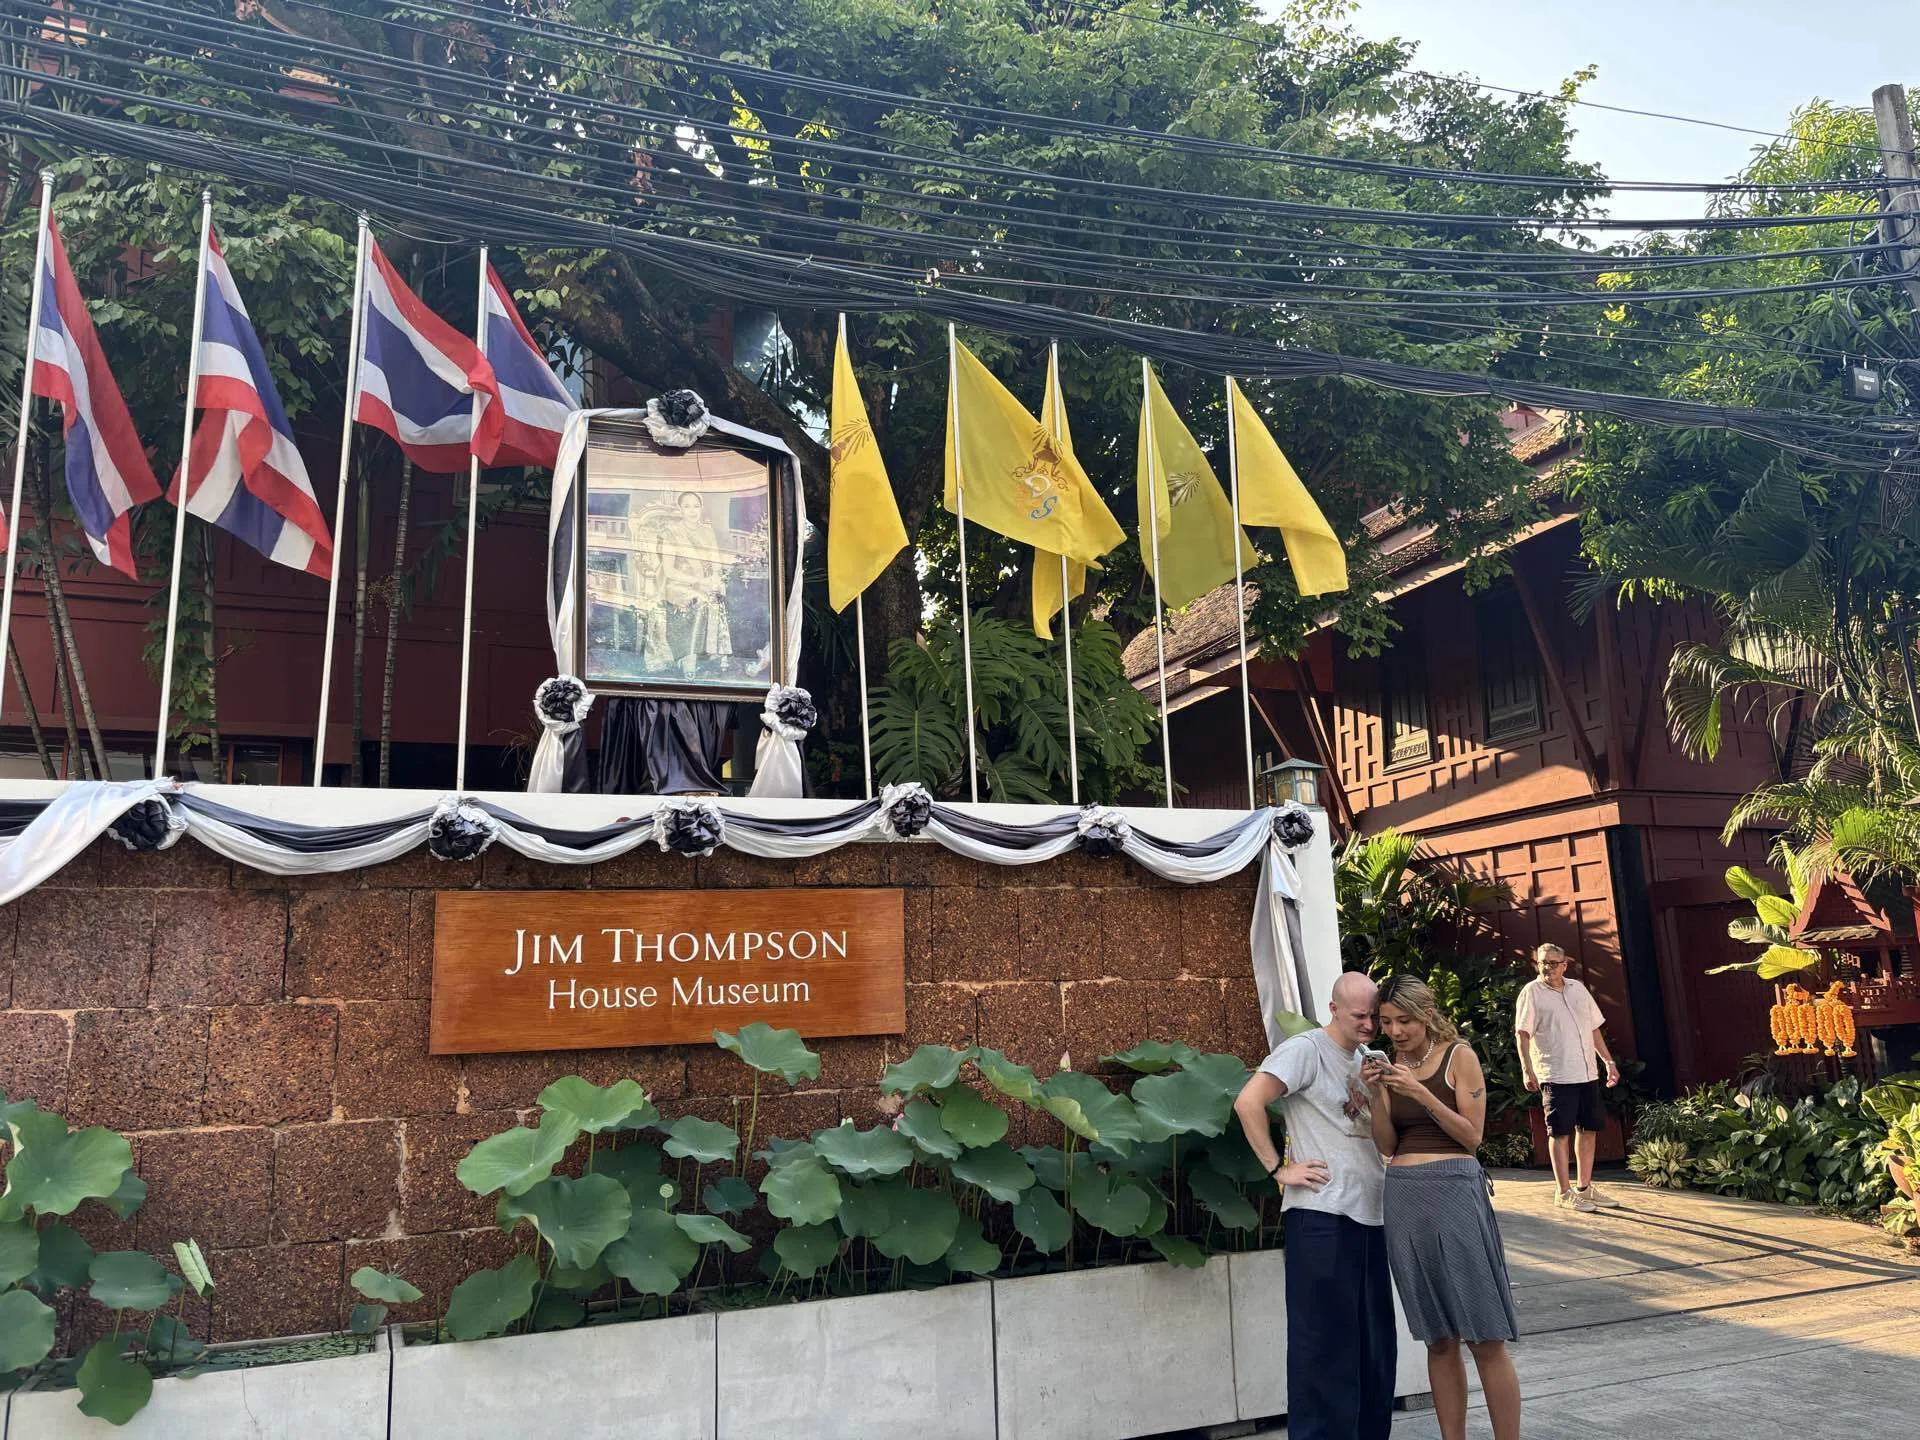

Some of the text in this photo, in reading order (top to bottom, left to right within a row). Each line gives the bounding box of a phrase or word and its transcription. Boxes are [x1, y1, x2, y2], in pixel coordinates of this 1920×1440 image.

[504, 928, 848, 976] JIM THOMPSON
[547, 976, 811, 1010] House Museum
